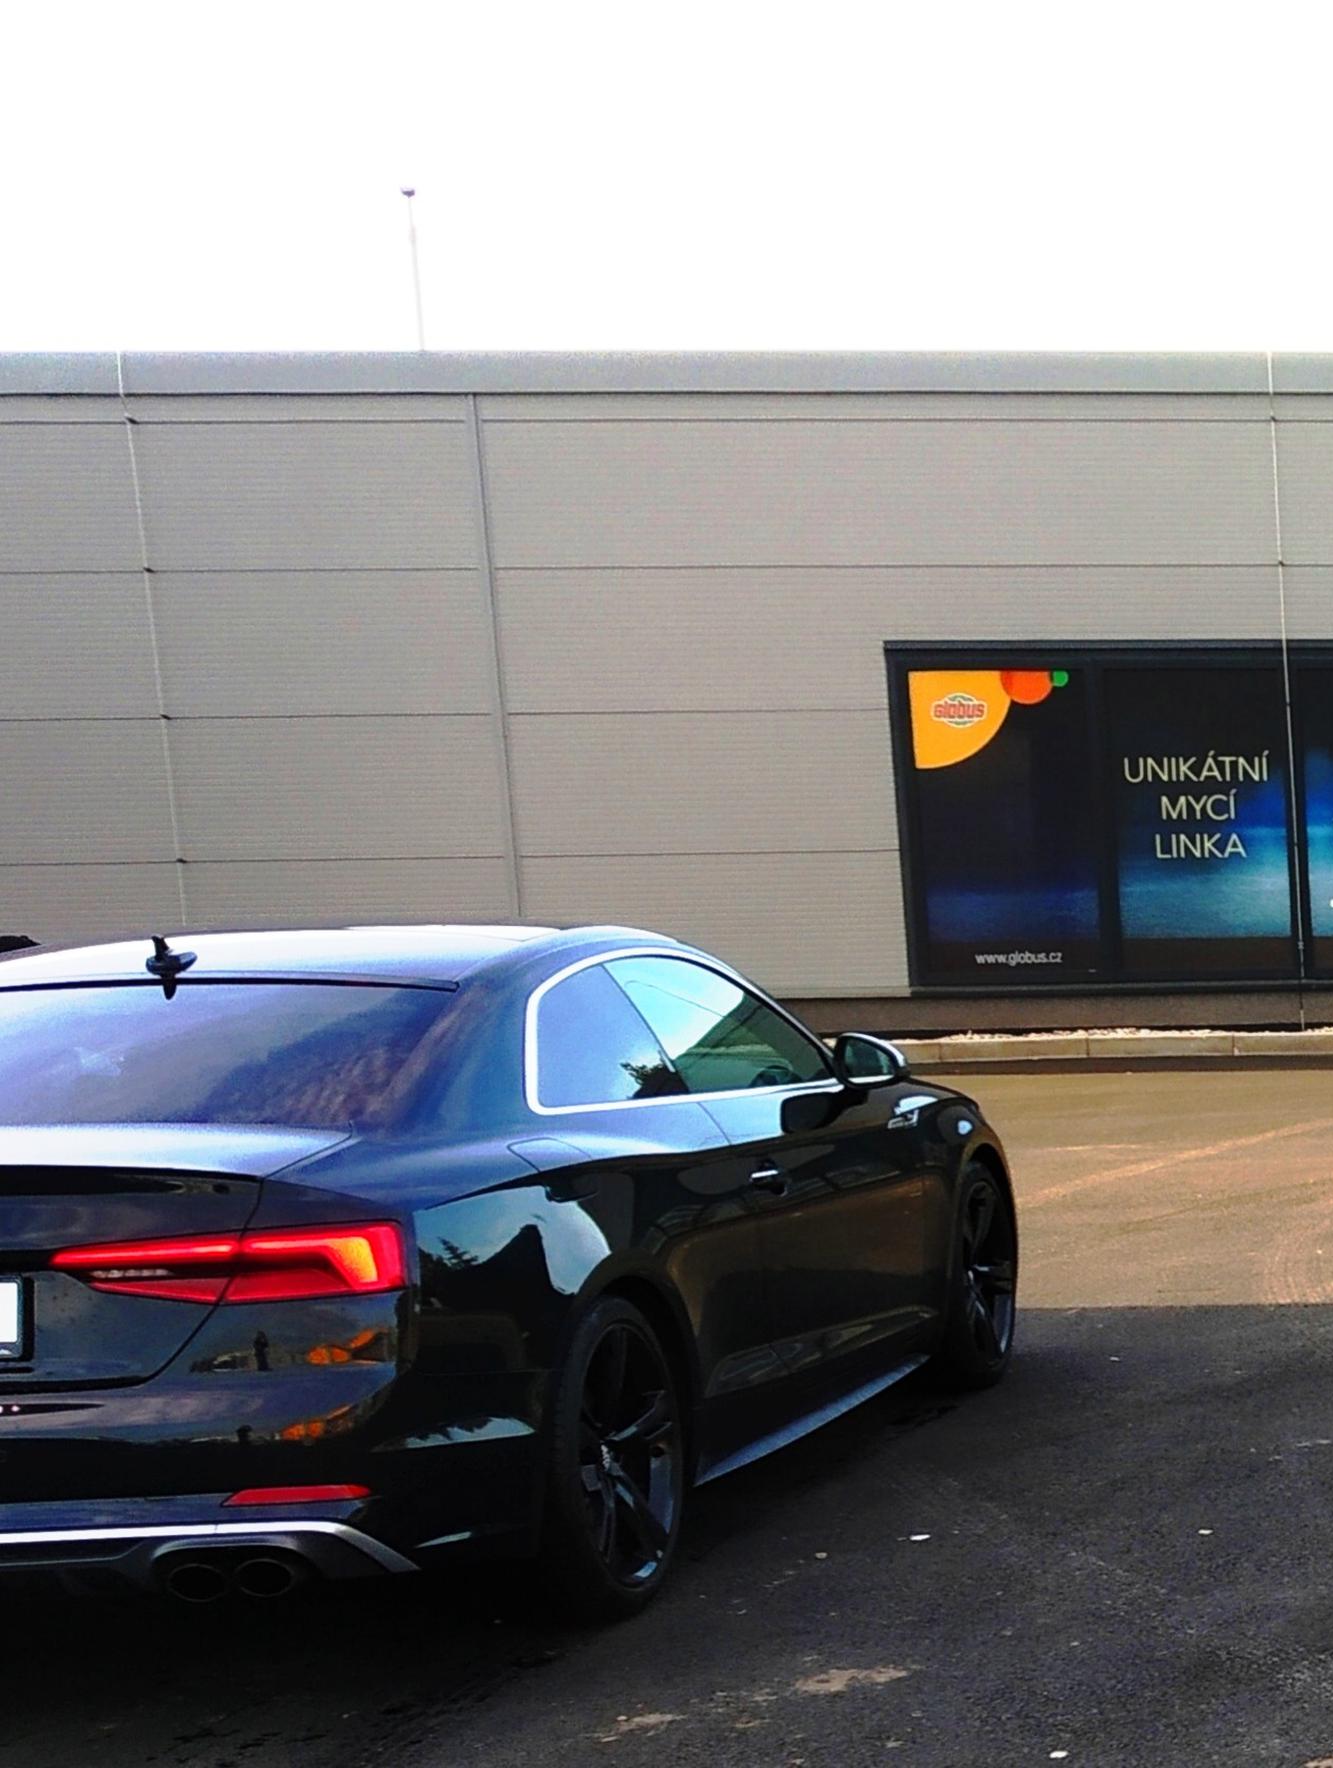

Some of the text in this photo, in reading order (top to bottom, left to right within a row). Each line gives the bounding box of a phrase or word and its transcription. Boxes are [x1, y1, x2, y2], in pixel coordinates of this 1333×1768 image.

[1123, 750, 1270, 784] UNIKÁTNÍ
[1160, 789, 1238, 821] MYCÍ
[1155, 831, 1247, 859] LINKA
[975, 950, 1063, 967] www.globus.cz
